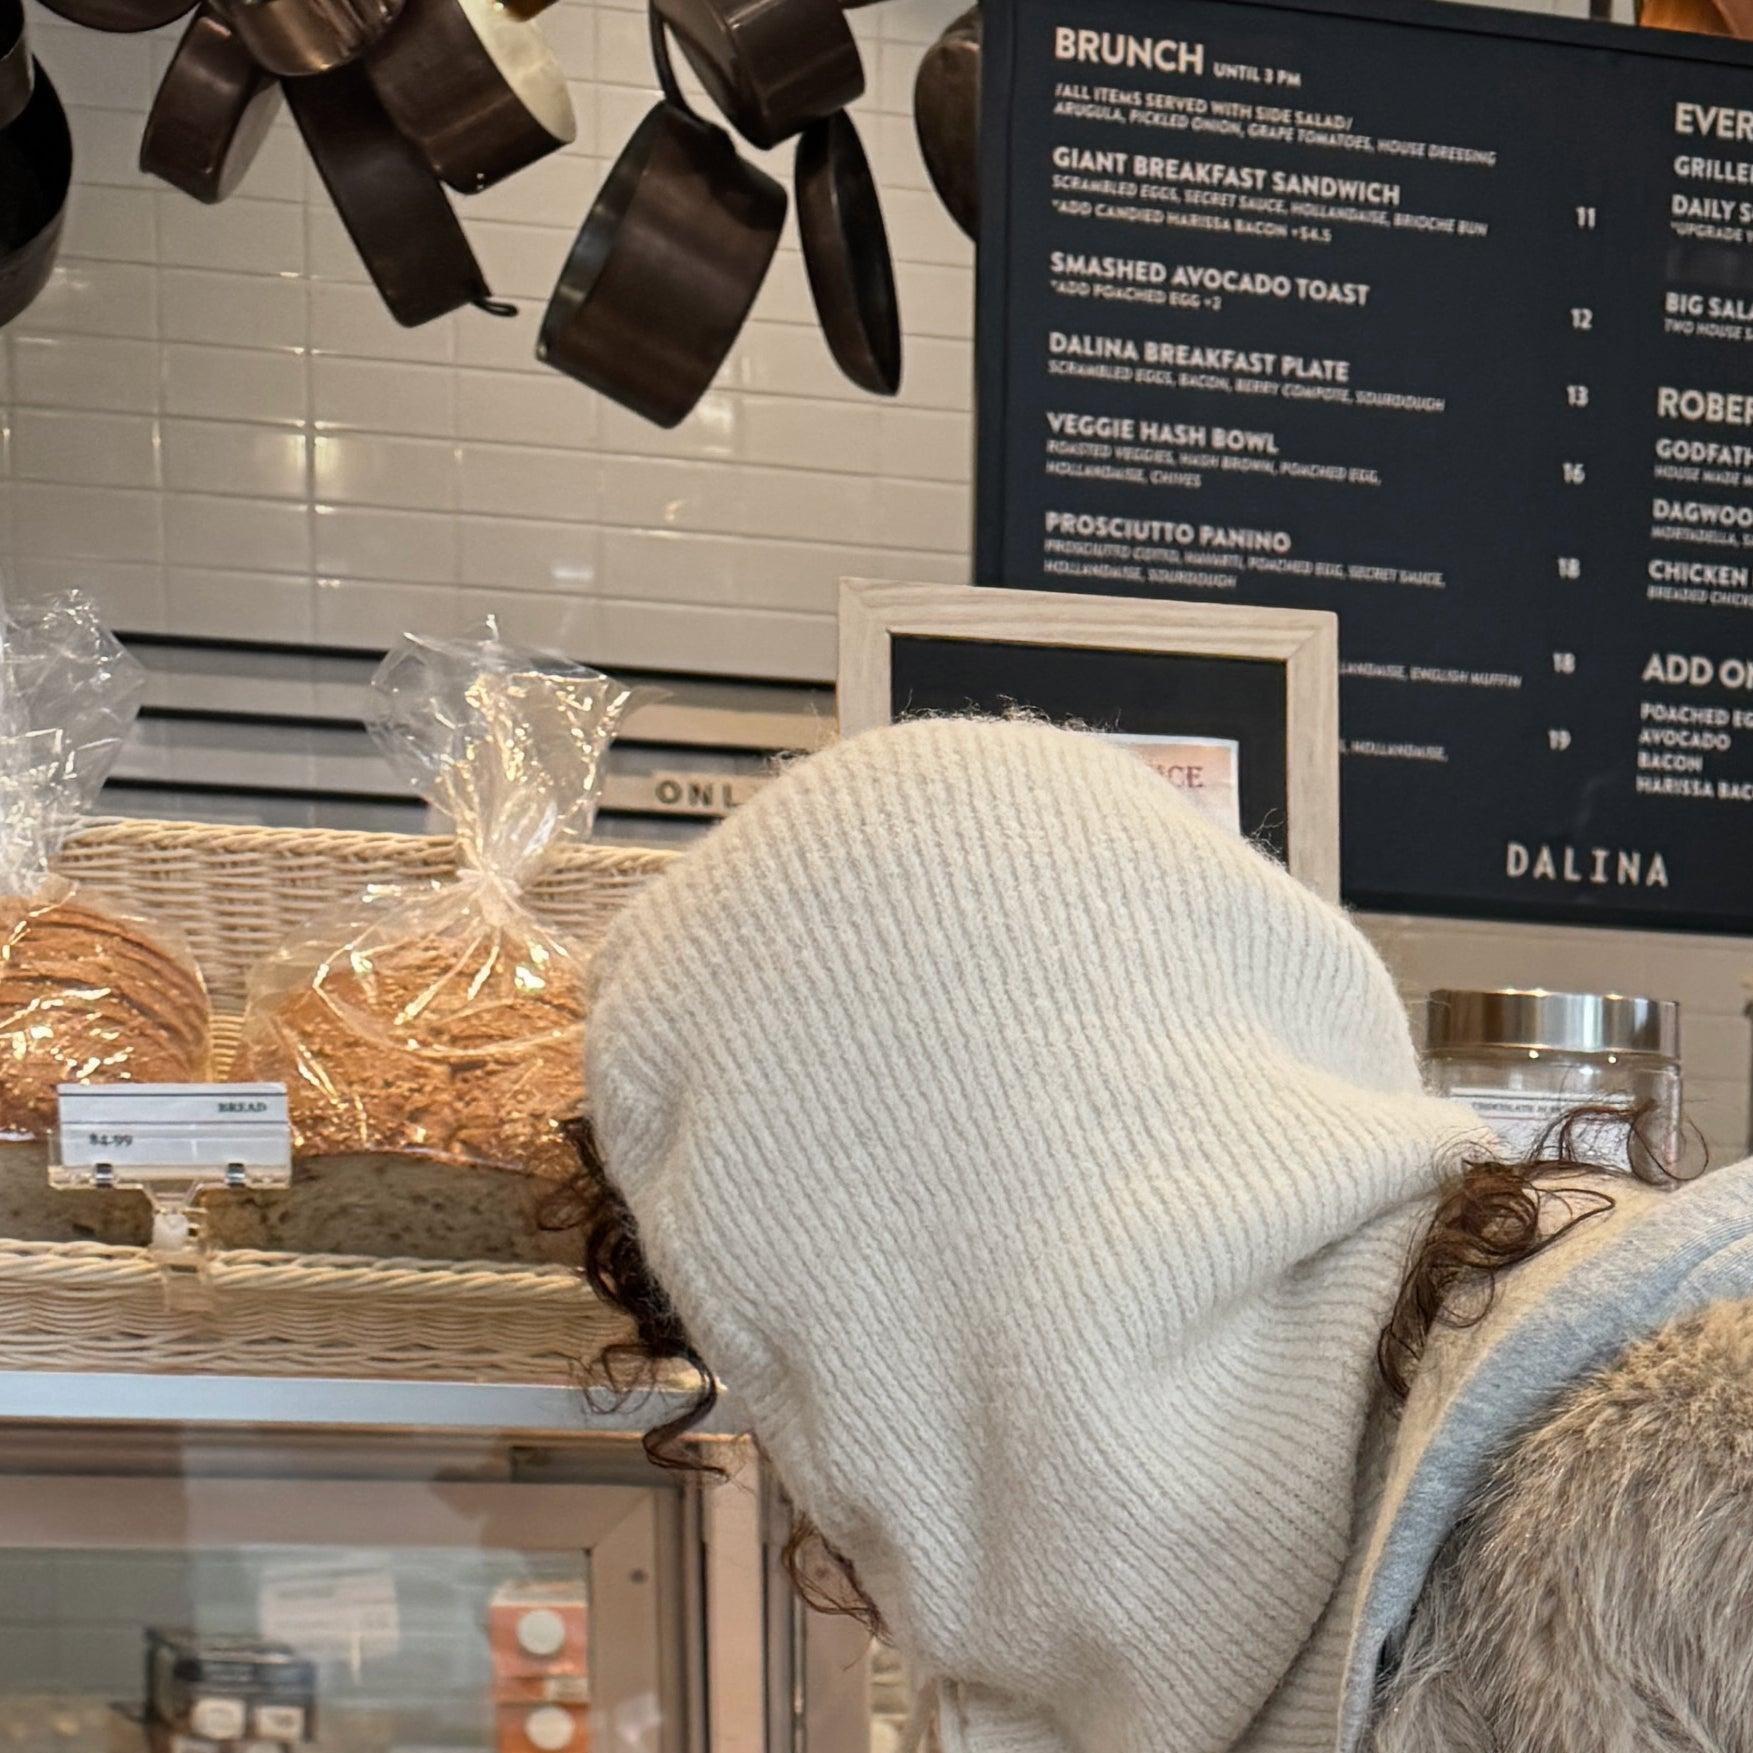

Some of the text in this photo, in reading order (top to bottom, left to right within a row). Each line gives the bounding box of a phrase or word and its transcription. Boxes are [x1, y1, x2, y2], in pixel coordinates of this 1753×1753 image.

[1055, 26, 1301, 87] BRUNCH UNTIL 3 PM
[1052, 146, 1596, 228] GIANT BREAKFAST SANDWICH 11
[1671, 194, 1736, 221] DAILY
[1051, 251, 1593, 330] SMASHED AVOCADO TOAST 12
[1665, 292, 1704, 316] BIG
[1049, 332, 1589, 407] DALINA BREAKFAST PLATE 13
[1046, 412, 1586, 484] VEGGIE HASH BOWL 16
[1045, 511, 1580, 579] PROSCIUTTO PANINO 18
[1648, 559, 1749, 586] CHICKEN
[1642, 654, 1714, 685] ADD
[1640, 702, 1730, 726] POACHED
[1548, 729, 1571, 750] 19
[1506, 842, 1668, 887] DALINA
[217, 1102, 268, 1113] BREAD
